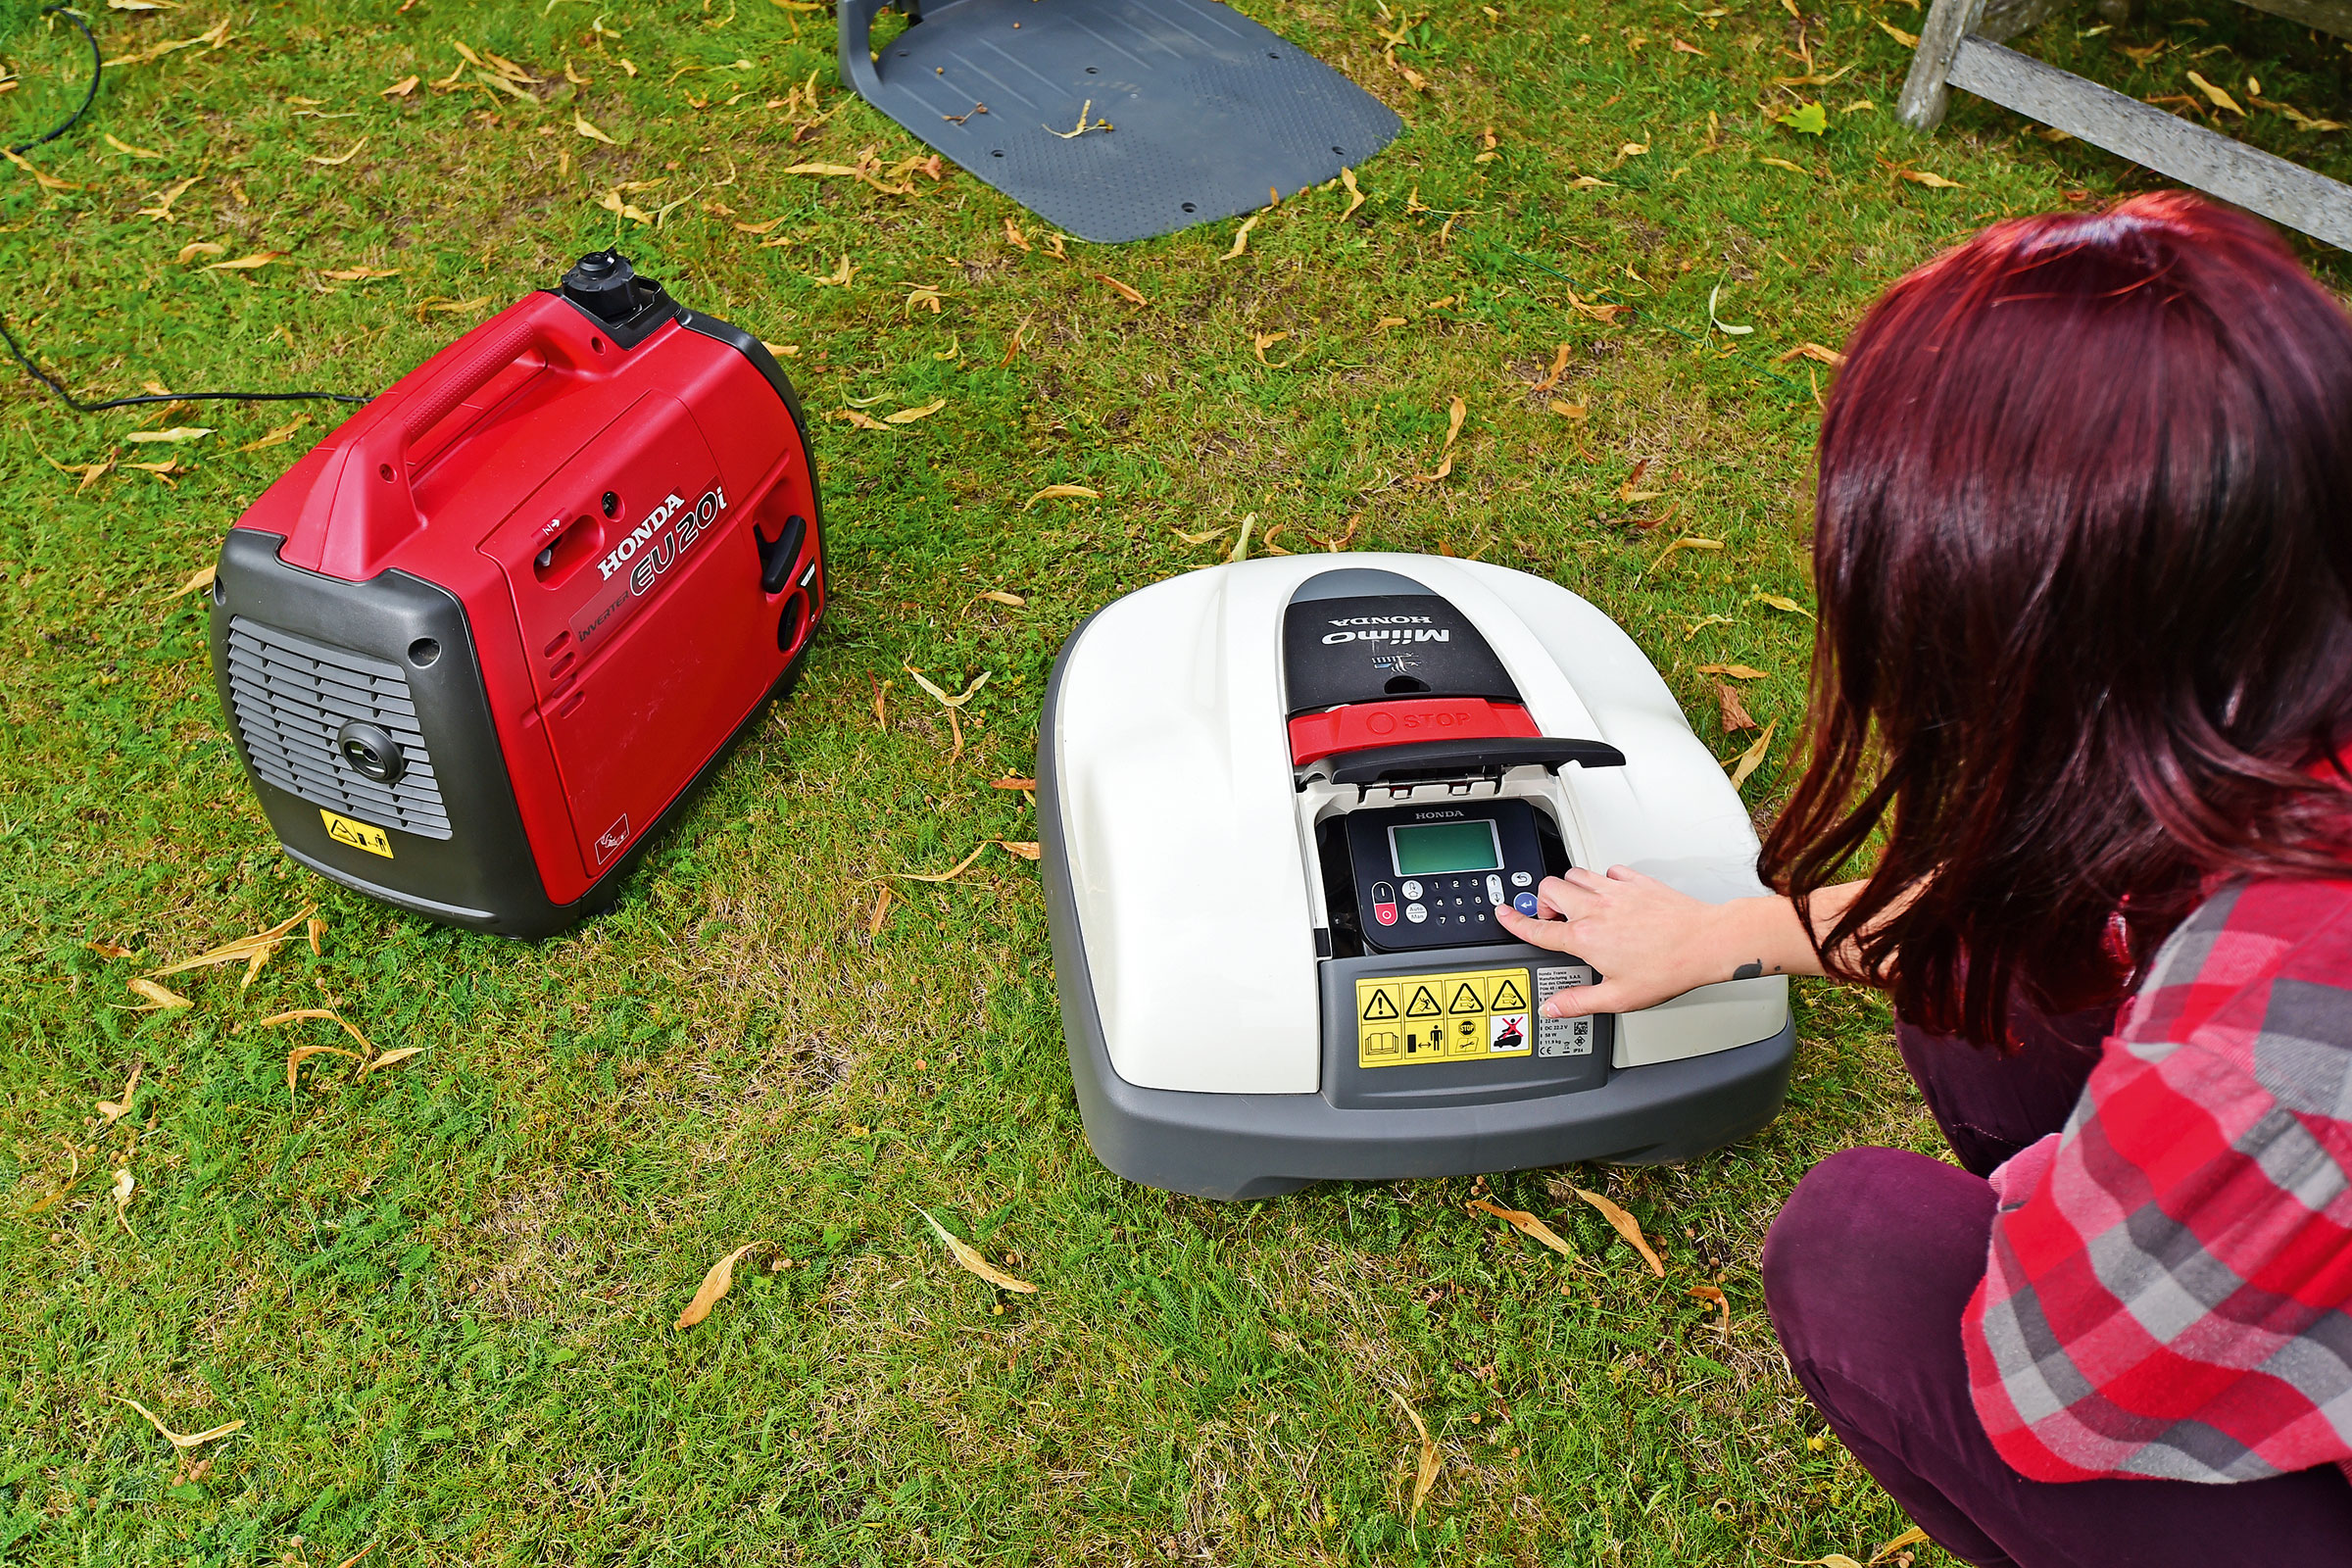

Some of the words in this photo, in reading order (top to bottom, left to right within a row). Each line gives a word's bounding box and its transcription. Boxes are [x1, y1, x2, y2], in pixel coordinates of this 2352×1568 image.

[597, 493, 686, 581] HONDA
[1328, 615, 1433, 627] HONDA
[1403, 712, 1471, 729] STOP
[1415, 810, 1464, 819] HONDA
